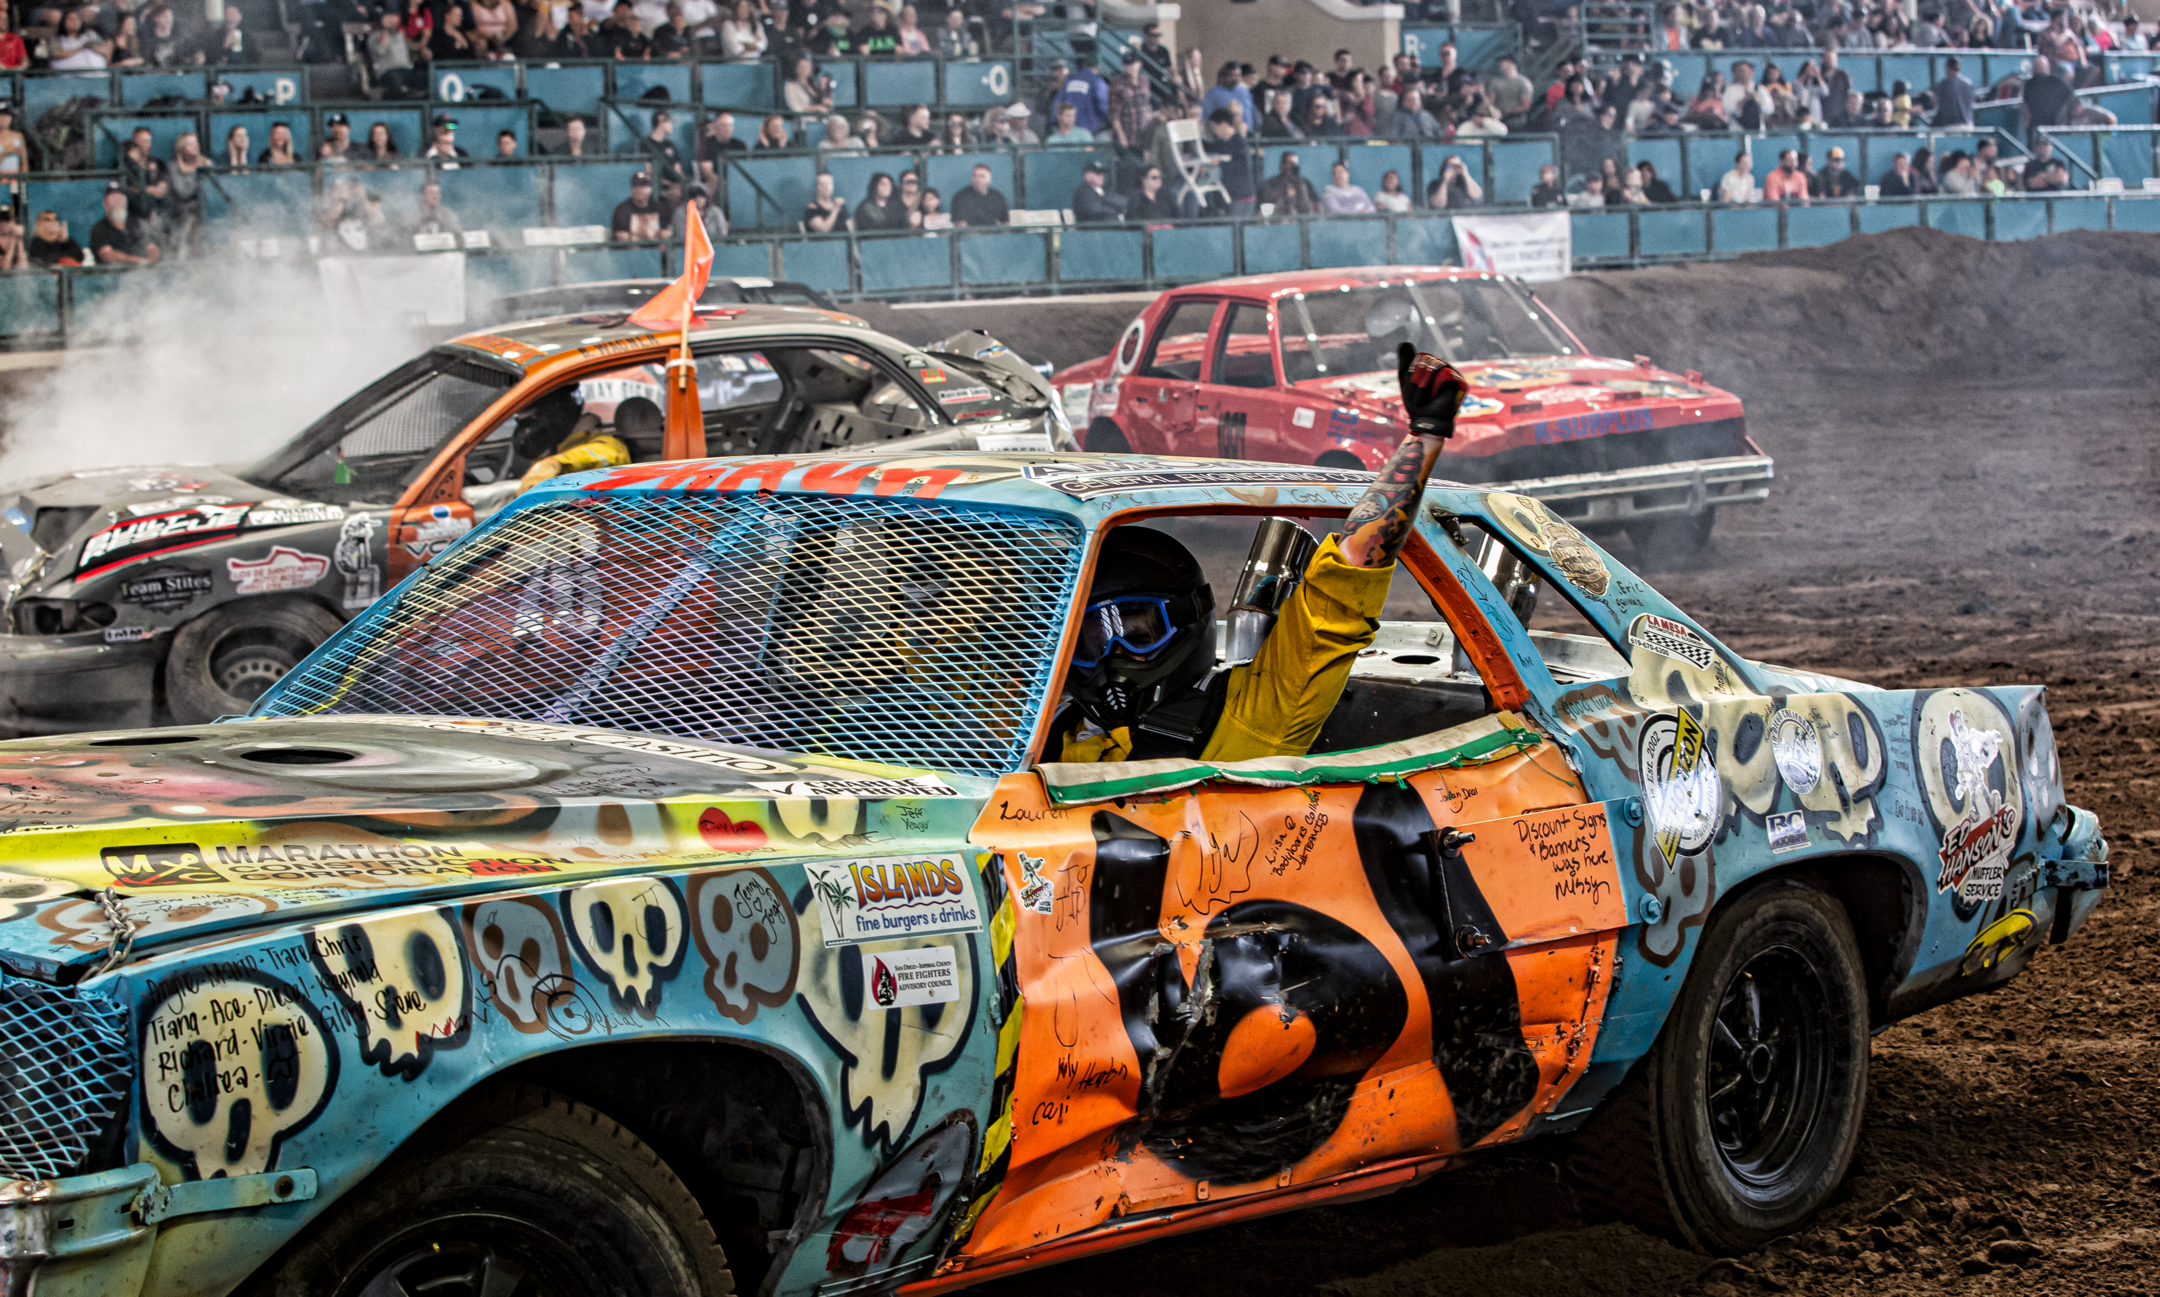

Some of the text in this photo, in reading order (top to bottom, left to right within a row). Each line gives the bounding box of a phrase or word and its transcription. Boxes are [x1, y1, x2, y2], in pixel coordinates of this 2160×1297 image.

[275, 78, 295, 105] P
[1534, 407, 1654, 444] K-SURPLUS
[1061, 474, 1180, 492] GENERAL
[121, 576, 212, 597] Team Stites
[1647, 615, 1688, 637] LA MESA
[1646, 731, 1661, 758] 2002
[810, 786, 959, 797] APPROVED
[1000, 800, 1070, 822] Lauren
[1767, 811, 1804, 834] RC
[1513, 810, 1607, 843] Discount Signs
[1944, 817, 1972, 855] ED
[215, 844, 464, 865] MARATHON
[1538, 835, 1591, 862] Banners
[1939, 808, 2016, 888] HANSON'S
[228, 857, 575, 873] CONSTRUCTION
[240, 865, 562, 880] CORPORATION
[1552, 858, 1581, 873] was
[1971, 866, 2003, 881] MUFFLER
[848, 858, 964, 910] ISLANDS
[1964, 883, 2002, 897] SERVICE
[733, 877, 766, 919] Jenny
[856, 905, 977, 932] fine burgers & drinks
[311, 934, 362, 957] Chris
[898, 969, 951, 981] FIRE FIGHTERS
[899, 979, 953, 991] ADVISORY COUNCIL
[210, 998, 247, 1027] Ace
[158, 1028, 241, 1082] Richard
